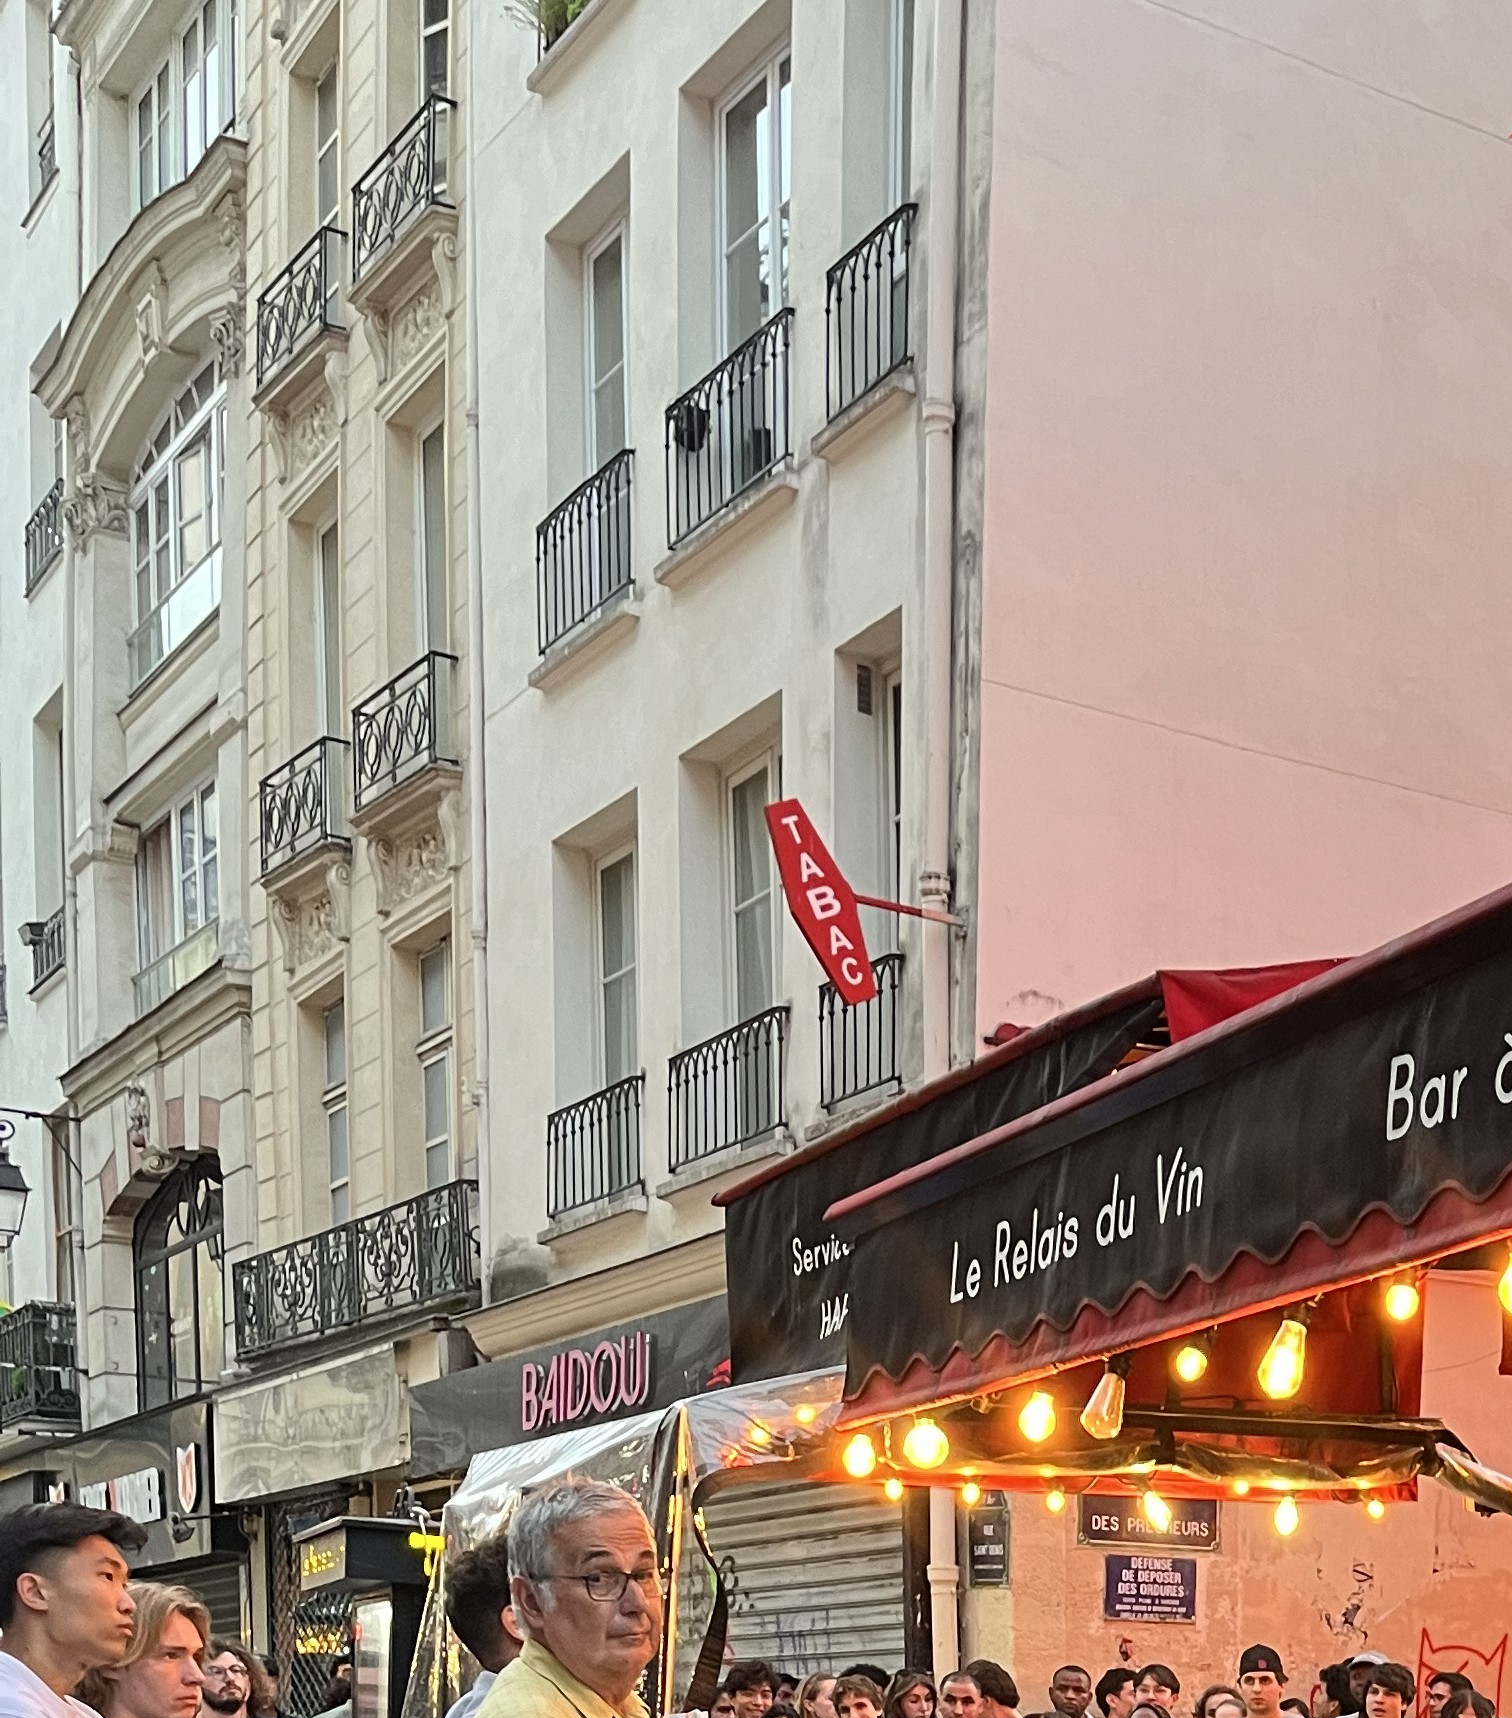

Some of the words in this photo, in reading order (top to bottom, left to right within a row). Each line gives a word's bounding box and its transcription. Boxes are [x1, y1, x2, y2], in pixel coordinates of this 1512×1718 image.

[780, 814, 864, 986] TABAC
[1386, 1053, 1469, 1141] Bar
[950, 1241, 981, 1304] Le
[993, 1207, 1080, 1288] Relais
[1095, 1173, 1136, 1247] du
[1156, 1146, 1204, 1224] Vin
[522, 1331, 650, 1431] BAIDOU
[1091, 1514, 1120, 1531] DES
[1117, 1582, 1137, 1595] DES
[1140, 1583, 1185, 1597] ORDURES
[1121, 1569, 1135, 1582] DE
[1138, 1570, 1182, 1584] DEPOSER
[1131, 1557, 1173, 1571] DEFENSE
